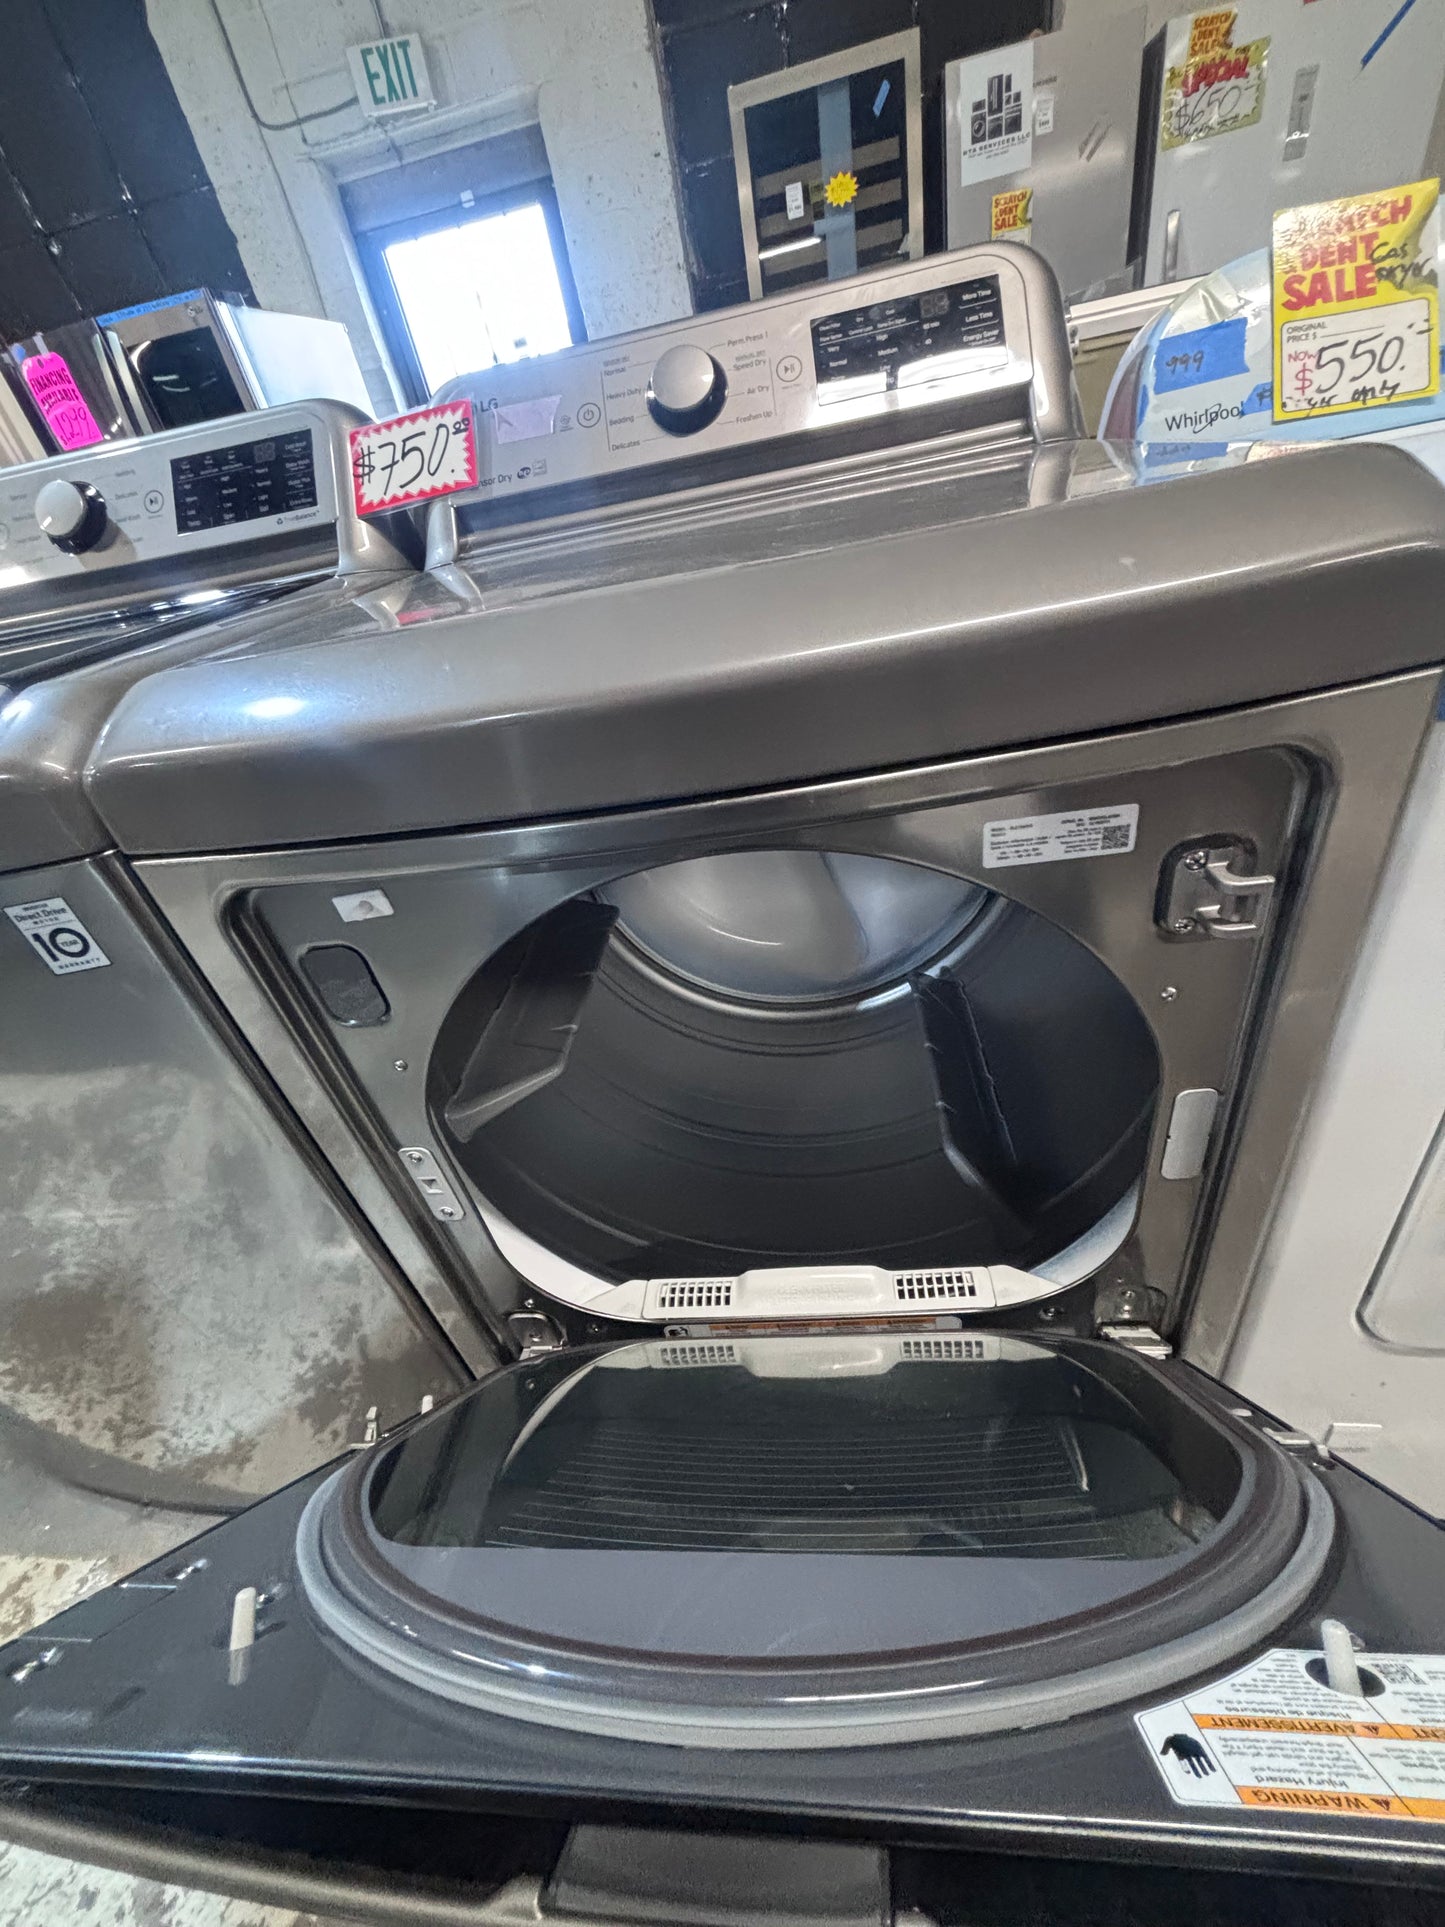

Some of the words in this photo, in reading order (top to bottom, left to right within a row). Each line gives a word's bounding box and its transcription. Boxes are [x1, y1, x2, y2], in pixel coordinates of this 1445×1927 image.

[360, 39, 419, 106] EXIT
[1281, 263, 1379, 311] SALE
[1286, 321, 1327, 334] ORIGINAL
[1286, 333, 1312, 343] PRICE
[1287, 350, 1316, 363] NOW
[755, 358, 767, 368] Dry
[627, 387, 643, 398] Duty
[758, 385, 770, 394] Dry
[480, 398, 499, 413] LG
[762, 411, 773, 420] Up
[612, 440, 640, 451] Delicates
[497, 473, 513, 484] Dry
[13, 910, 42, 922] Direct
[44, 907, 68, 917] Drive
[32, 927, 90, 962] 10
[1210, 1716, 1356, 1734] AVERTISSEMENT
[1254, 1775, 1304, 1786] Hazard
[1308, 1777, 1349, 1789] Injury
[1251, 1789, 1369, 1810] WARNING
